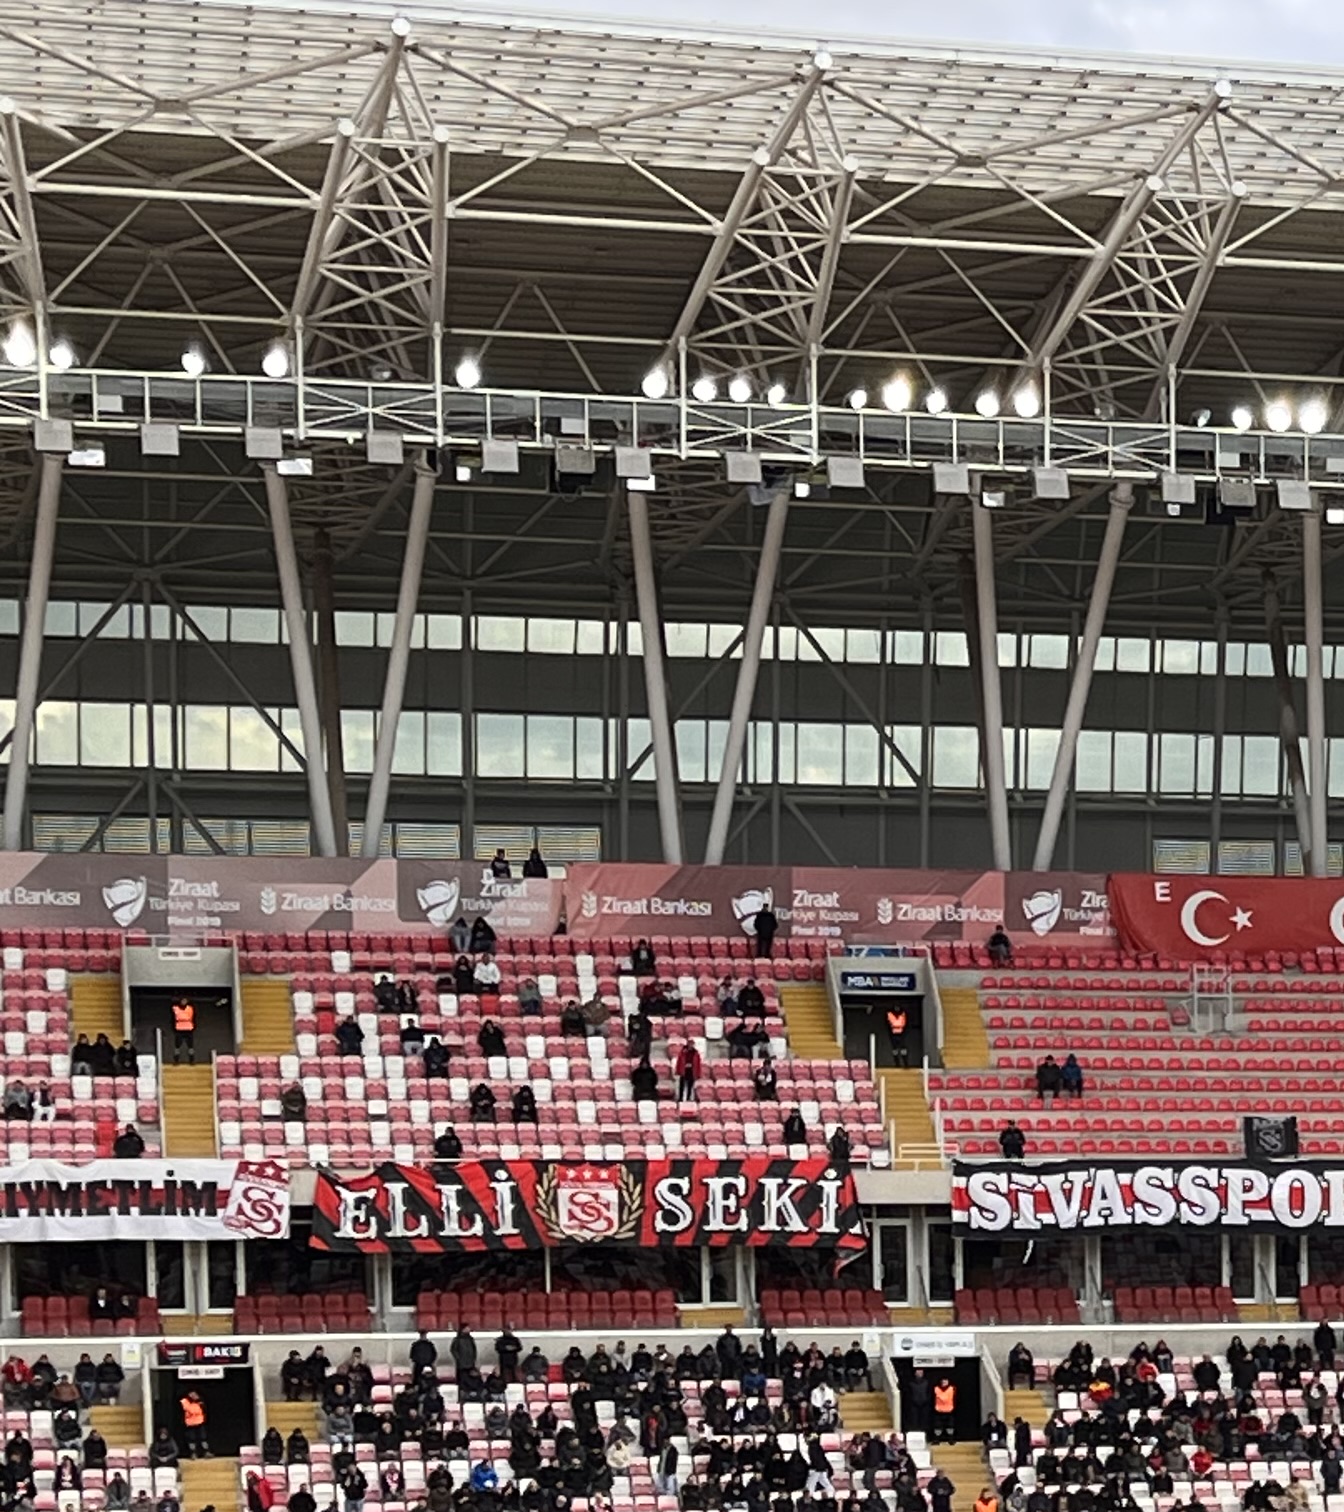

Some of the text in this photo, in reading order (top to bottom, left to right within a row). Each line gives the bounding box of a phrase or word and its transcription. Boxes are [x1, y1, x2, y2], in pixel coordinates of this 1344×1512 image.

[14, 886, 81, 906] Bankası
[168, 878, 220, 898] Ziraat
[480, 883, 528, 898] Ziraat
[1154, 881, 1173, 903] E
[280, 892, 396, 912] Ziraat Bankası
[600, 896, 713, 916] Ziraat Bankası
[792, 889, 840, 908] Ziraat
[1080, 889, 1109, 909] Zira
[774, 907, 860, 924] Türkiye Kupası
[896, 903, 1004, 923] Ziraat Bankası
[333, 1168, 522, 1240] ELLİ
[652, 1168, 863, 1234] SEKİ
